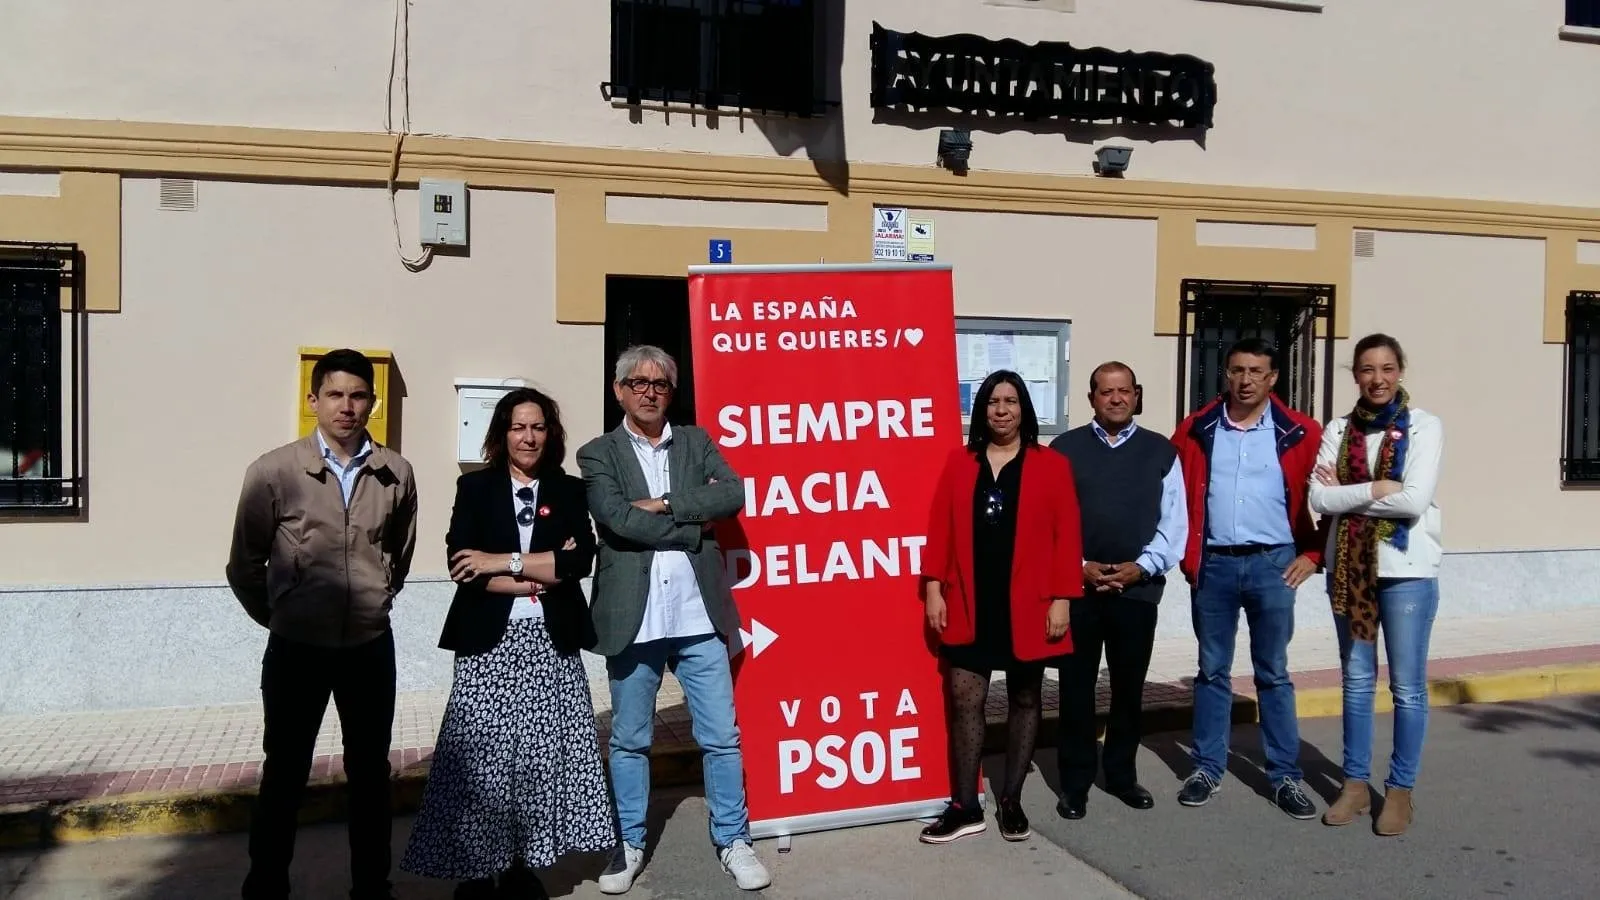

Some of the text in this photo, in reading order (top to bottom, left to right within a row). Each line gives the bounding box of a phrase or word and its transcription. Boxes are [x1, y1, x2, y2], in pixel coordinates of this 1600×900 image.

[889, 48, 1201, 110] AYUNTAMIENTO
[716, 243, 724, 259] 5
[710, 296, 858, 321] LA ESPAÑA
[712, 332, 767, 353] QUE
[718, 397, 935, 448] SIEMPRE
[726, 535, 928, 590] DELANT
[779, 688, 919, 728] VOTA
[778, 726, 922, 795] PSOE
